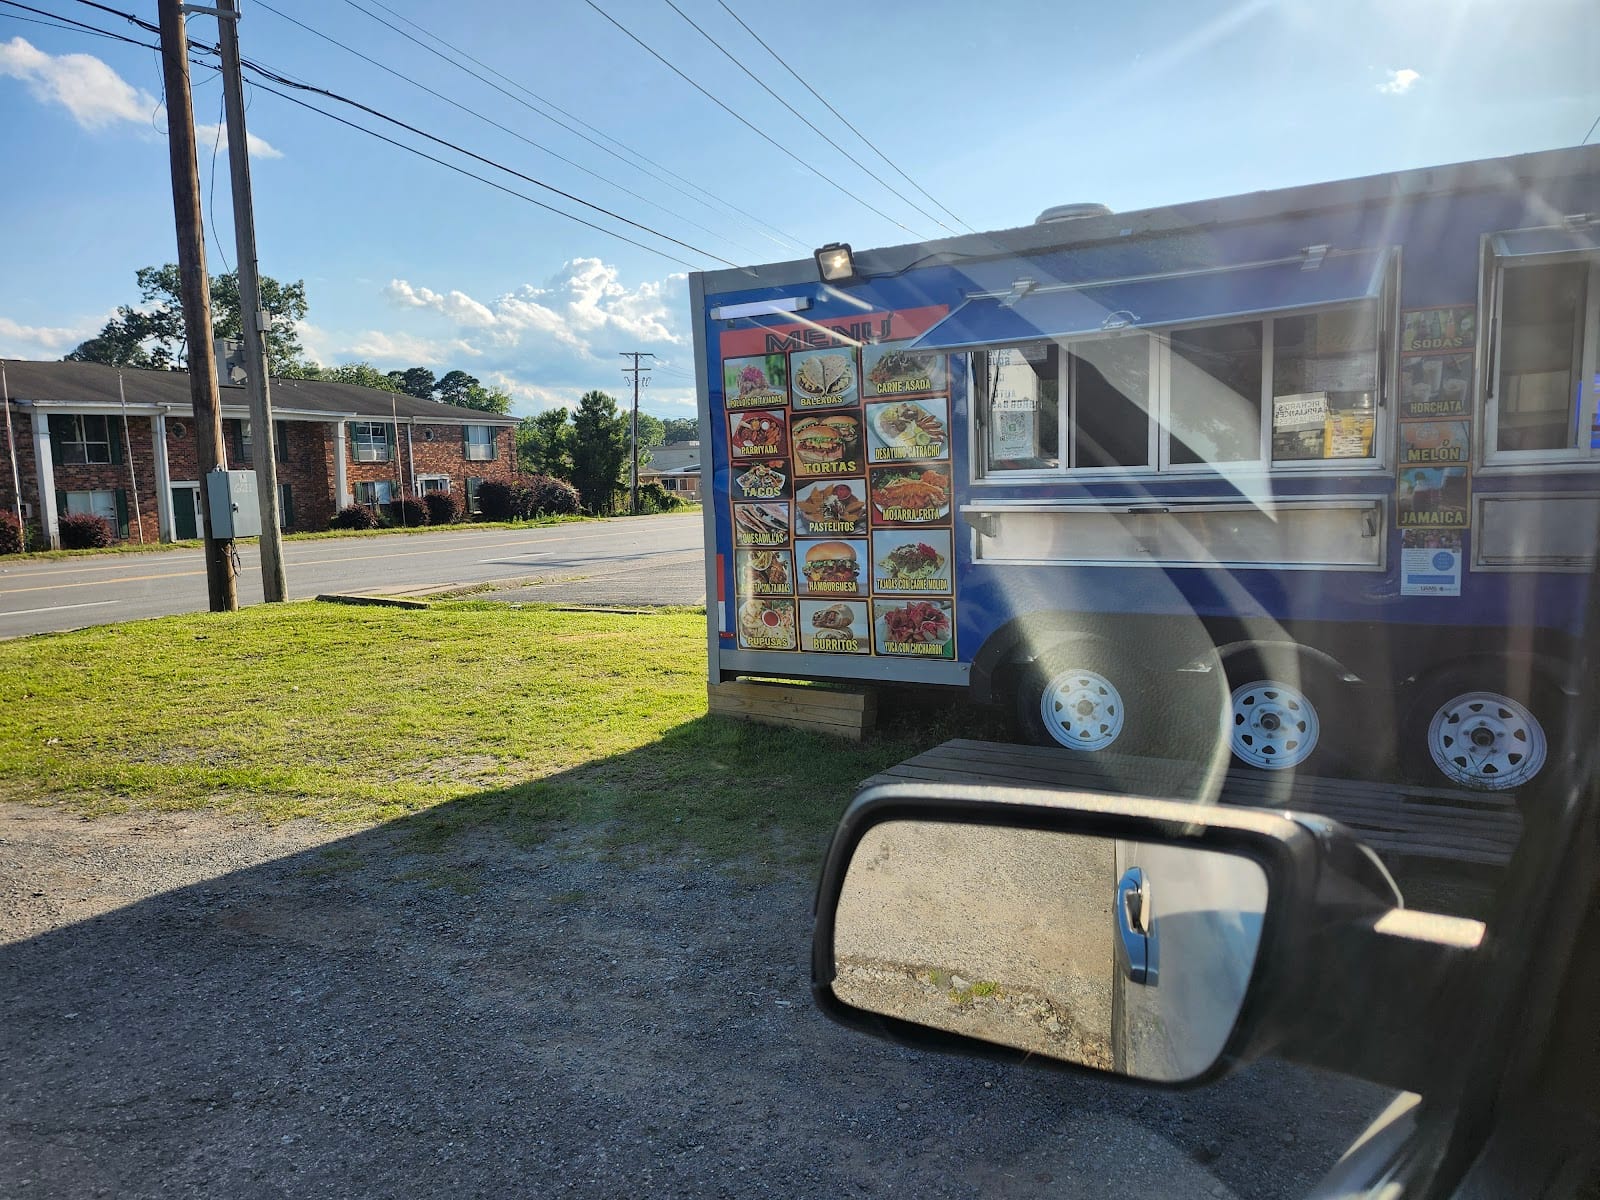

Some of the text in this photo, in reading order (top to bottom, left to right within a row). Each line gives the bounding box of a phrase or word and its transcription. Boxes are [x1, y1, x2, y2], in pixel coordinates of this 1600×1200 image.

[1411, 338, 1463, 350] SODAS
[877, 379, 931, 394] CARNE ASADA
[747, 397, 760, 406] CON
[760, 395, 782, 405] TAJADAS
[801, 395, 843, 406] BALEADAS
[1410, 401, 1462, 413] HORCHATA
[875, 444, 940, 460] DESAYUNO CATRACHO
[804, 461, 857, 474] TORTAS
[743, 486, 781, 497] TACOS
[883, 508, 940, 521] MOJARRA FRITA
[1401, 511, 1464, 524] JAMAICA
[809, 521, 855, 532] PASTELITOS
[742, 532, 784, 544] QUESADILLAS
[771, 583, 790, 593] TAJADAS
[808, 581, 857, 592] HAMBURGUESA
[876, 578, 948, 590] TAJADAS CON CARNE MOLIDA
[748, 637, 788, 647] PUPUSAS
[813, 638, 858, 651] BURRITOS
[885, 641, 943, 655] YUCA CON CHICHARRON
